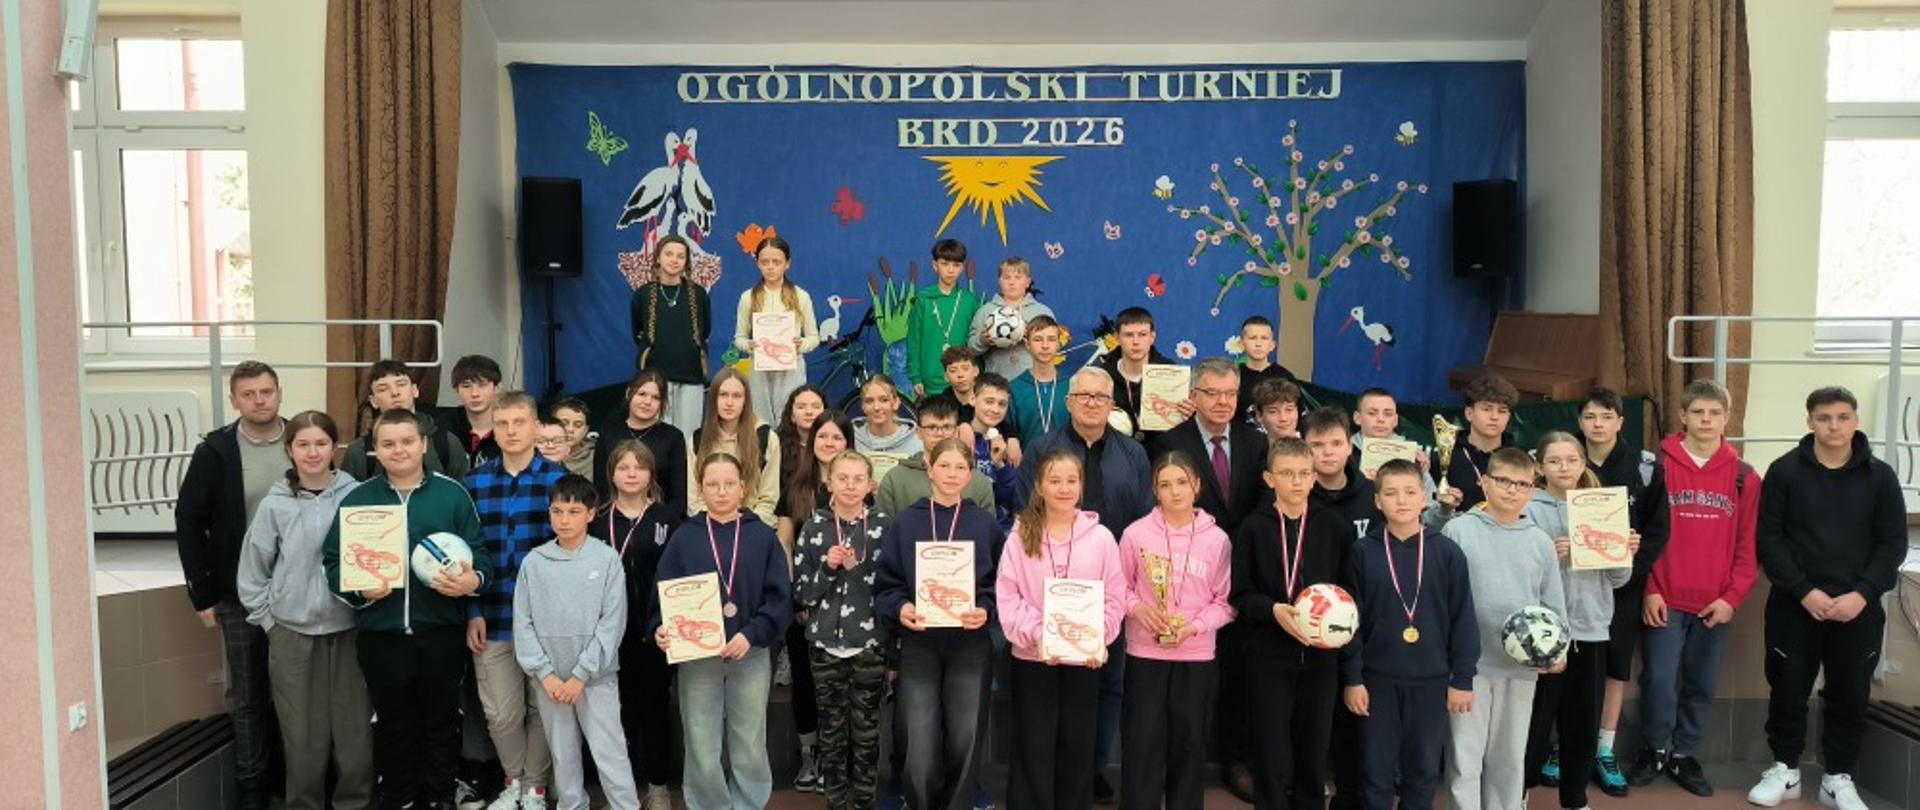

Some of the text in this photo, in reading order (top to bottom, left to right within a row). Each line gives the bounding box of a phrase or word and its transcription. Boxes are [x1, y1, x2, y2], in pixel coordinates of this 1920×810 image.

[677, 65, 1343, 102] OGÓLNOPOLSKI TURNIEJ
[898, 117, 1125, 148] BRD 2026
